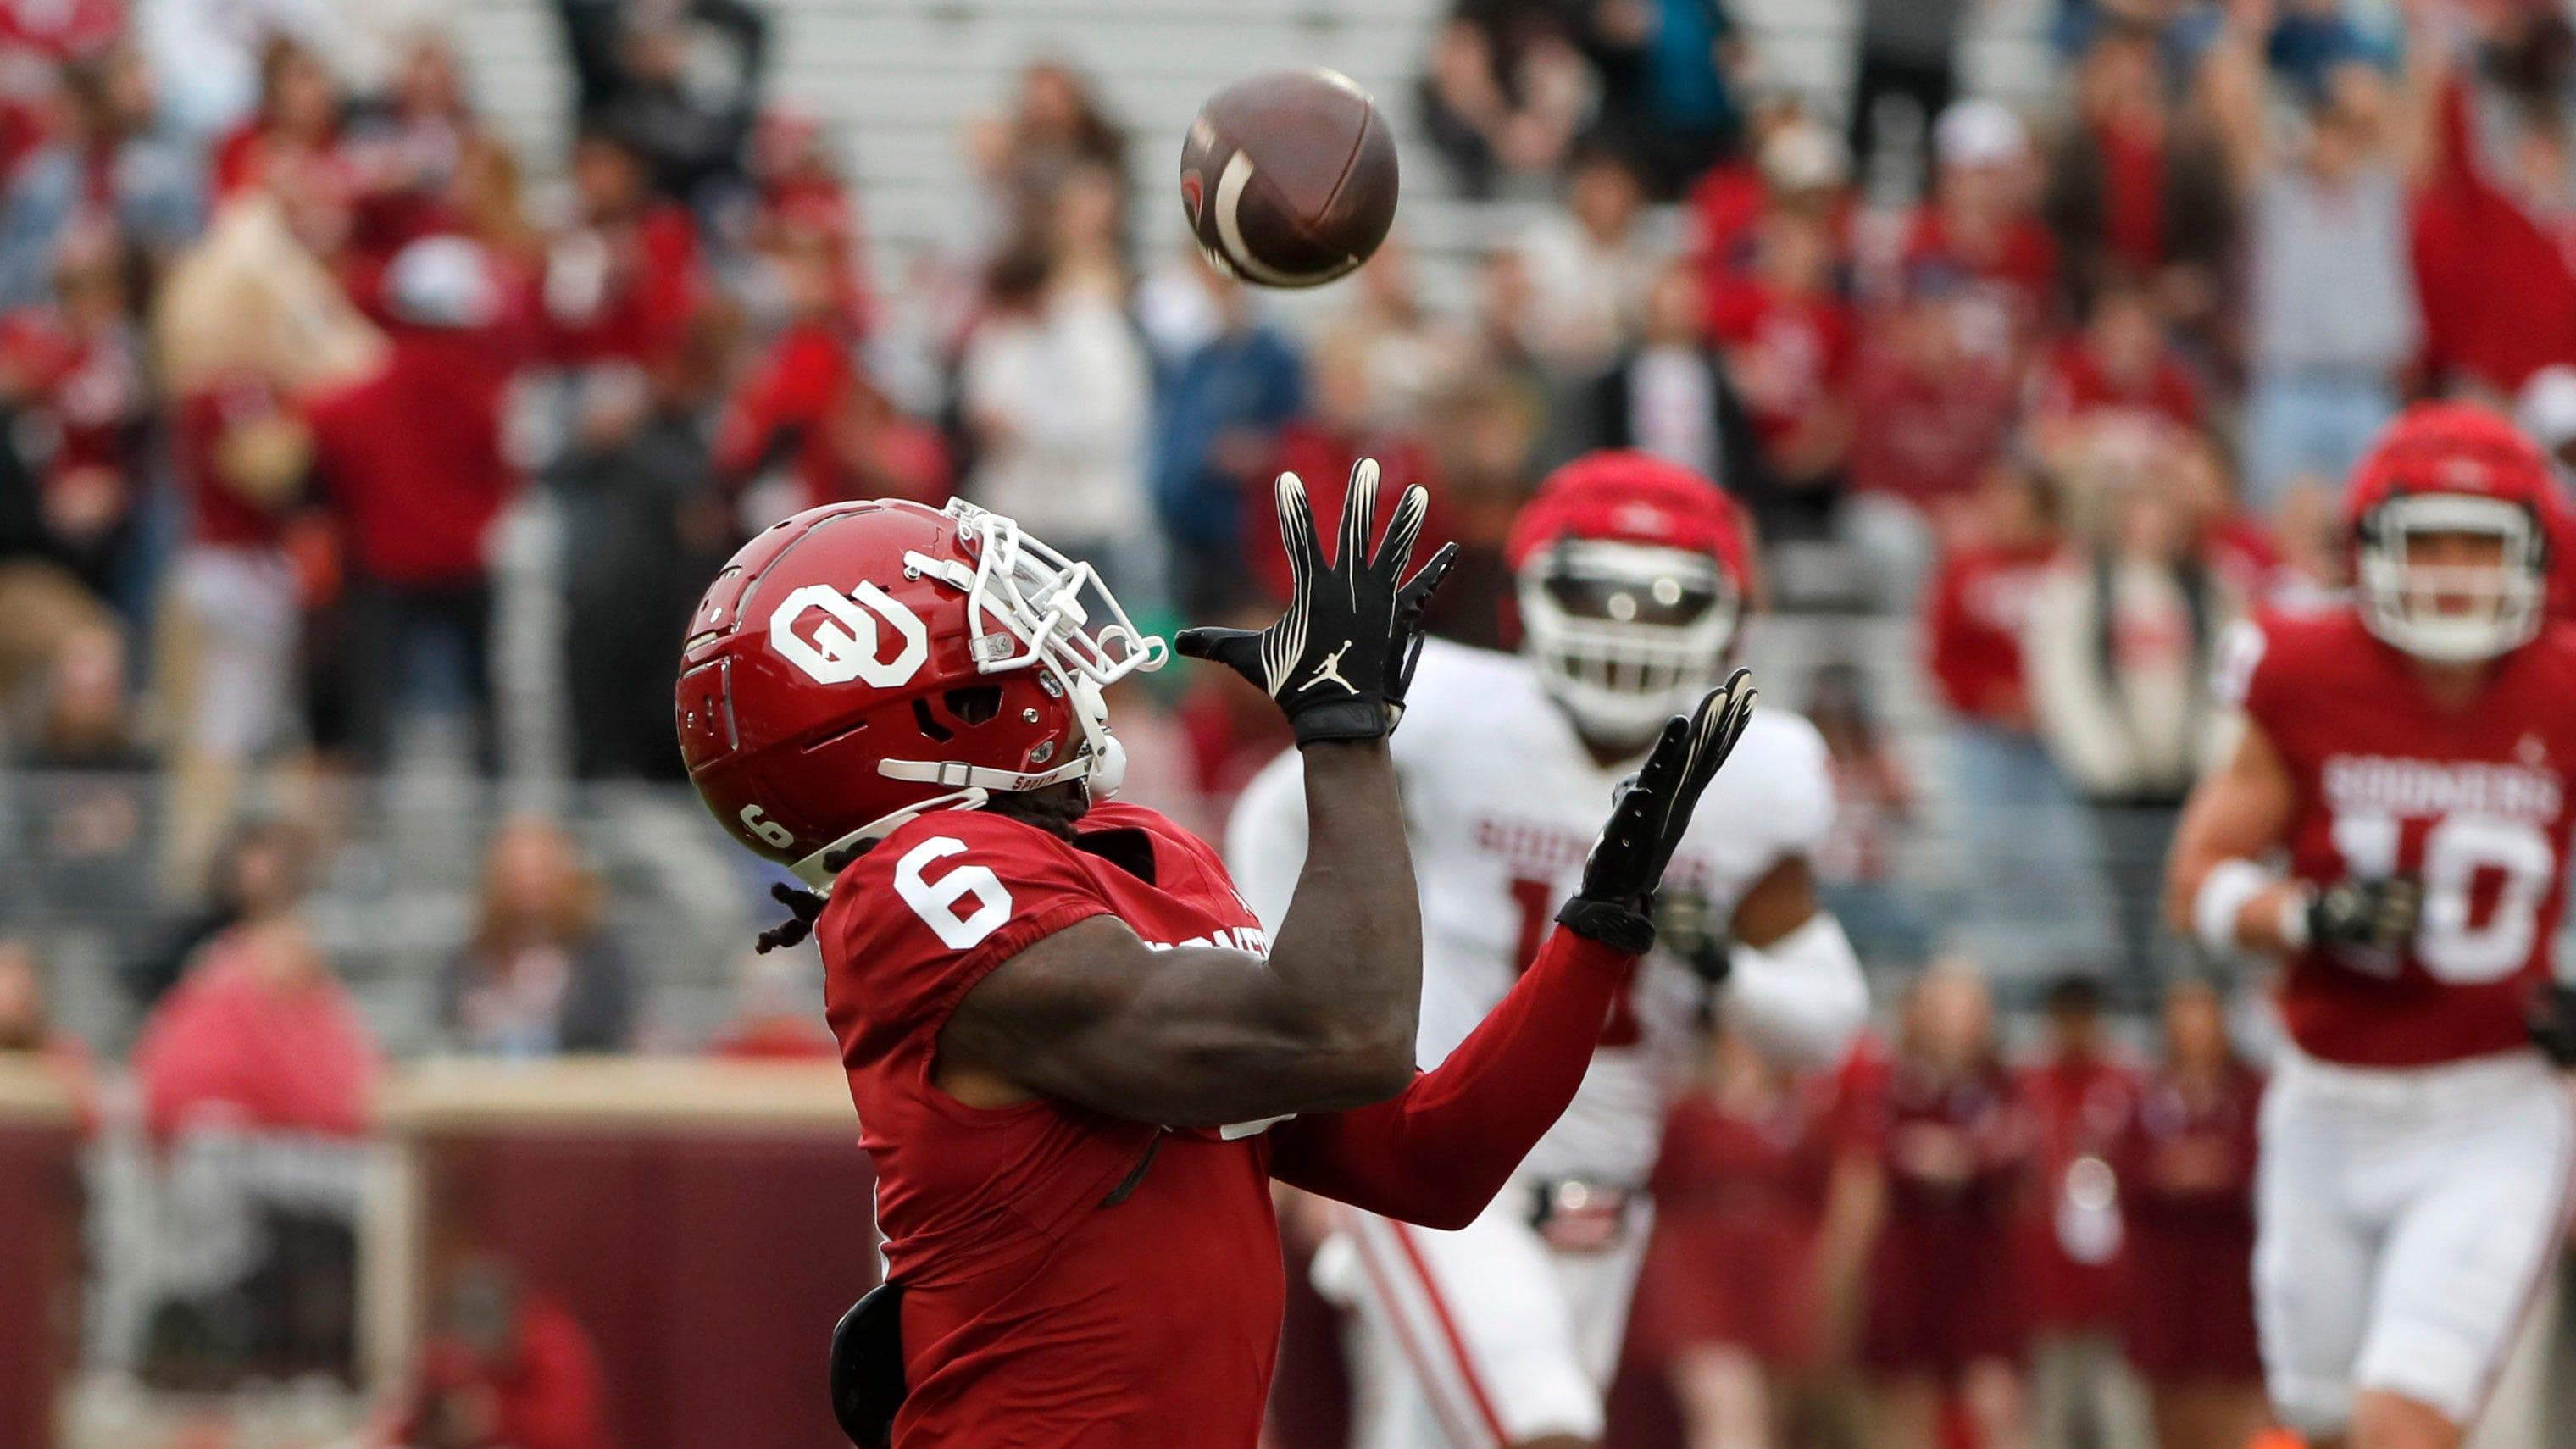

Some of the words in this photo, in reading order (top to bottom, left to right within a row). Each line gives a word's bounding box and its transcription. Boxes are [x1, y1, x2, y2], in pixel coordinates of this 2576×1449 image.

[769, 580, 929, 688] OU
[740, 803, 795, 848] 6
[894, 836, 1013, 950] 6
